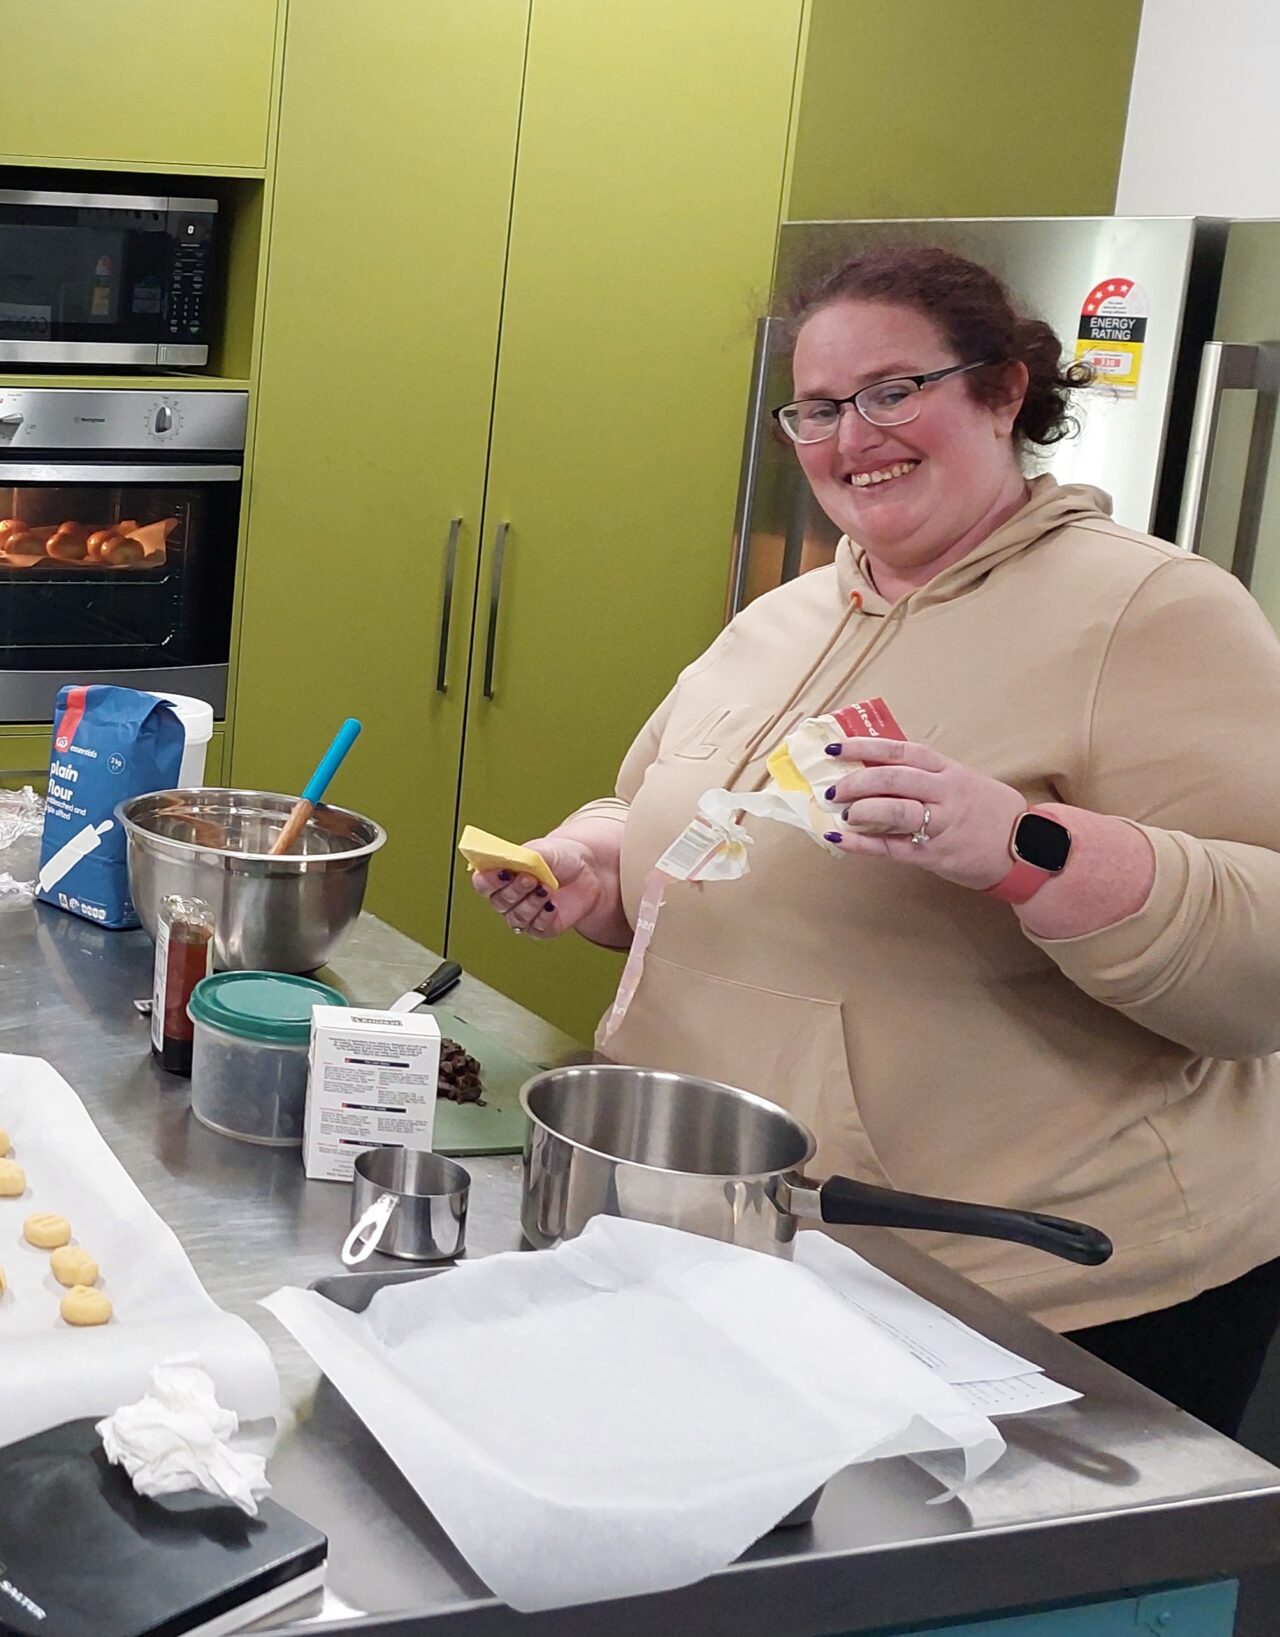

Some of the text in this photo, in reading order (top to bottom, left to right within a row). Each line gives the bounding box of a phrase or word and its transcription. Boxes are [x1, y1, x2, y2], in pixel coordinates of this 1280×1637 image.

[187, 225, 194, 234] 0
[1090, 317, 1136, 329] ENERGY
[1091, 328, 1131, 340] RATING
[70, 745, 97, 758] essentials
[50, 760, 78, 782] plain
[48, 778, 73, 801] flour
[74, 807, 87, 816] and
[0, 1580, 47, 1620] SALTER
